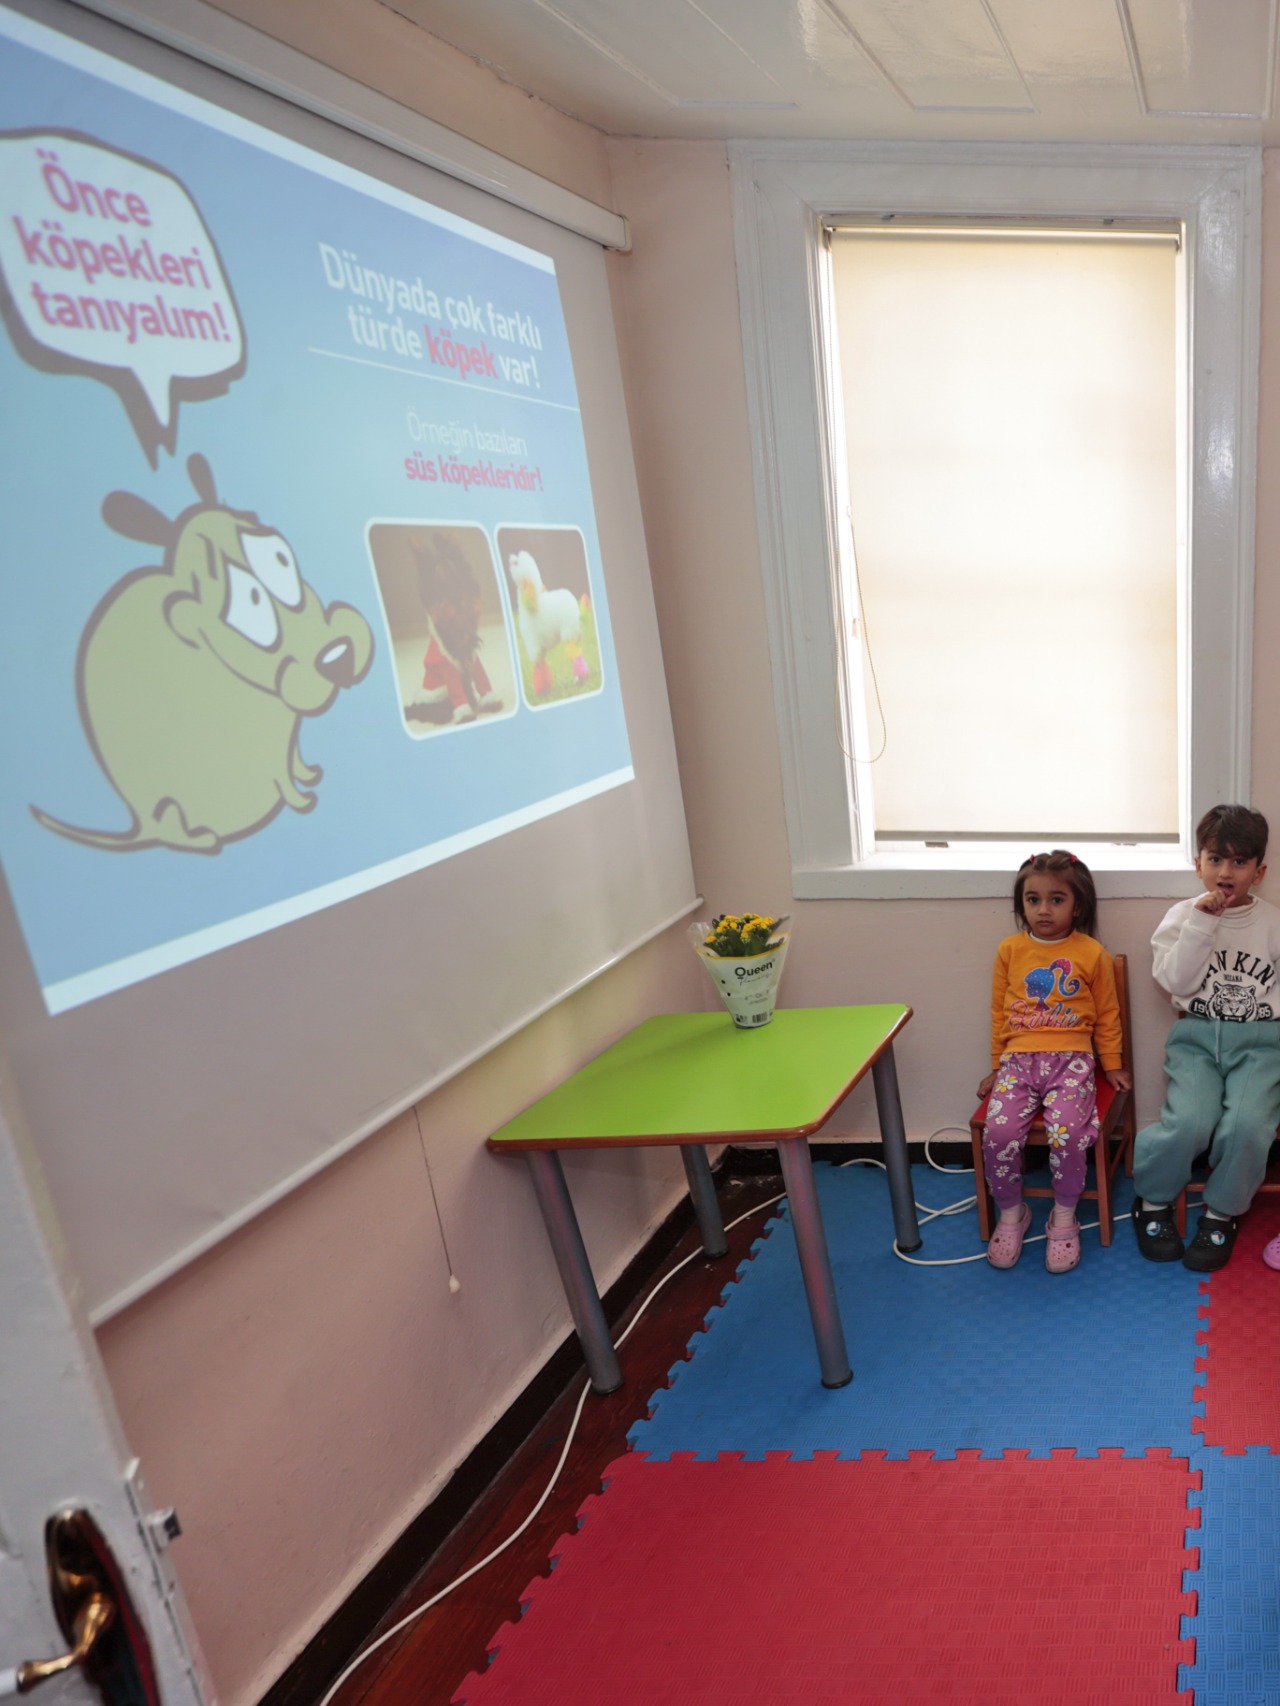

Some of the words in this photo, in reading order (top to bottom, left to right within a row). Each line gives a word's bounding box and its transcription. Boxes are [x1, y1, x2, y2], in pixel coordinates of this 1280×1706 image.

[36, 147, 152, 227] Önce
[12, 214, 211, 289] köpekleri
[31, 281, 231, 344] tanıyalım!
[318, 242, 441, 320] Dünyada
[445, 294, 486, 334] çok
[487, 302, 543, 350] farklı
[348, 305, 423, 359] türde
[424, 324, 498, 380] köpek
[498, 353, 540, 389] var!
[407, 405, 474, 455] Örneğin
[473, 423, 528, 457] bazıları
[404, 451, 438, 482] süs
[438, 454, 544, 492] köpekleridir!
[735, 962, 772, 979] Queen
[1009, 999, 1079, 1031] Barbie
[1194, 1001, 1205, 1013] 19
[1260, 1006, 1271, 1018] 85
